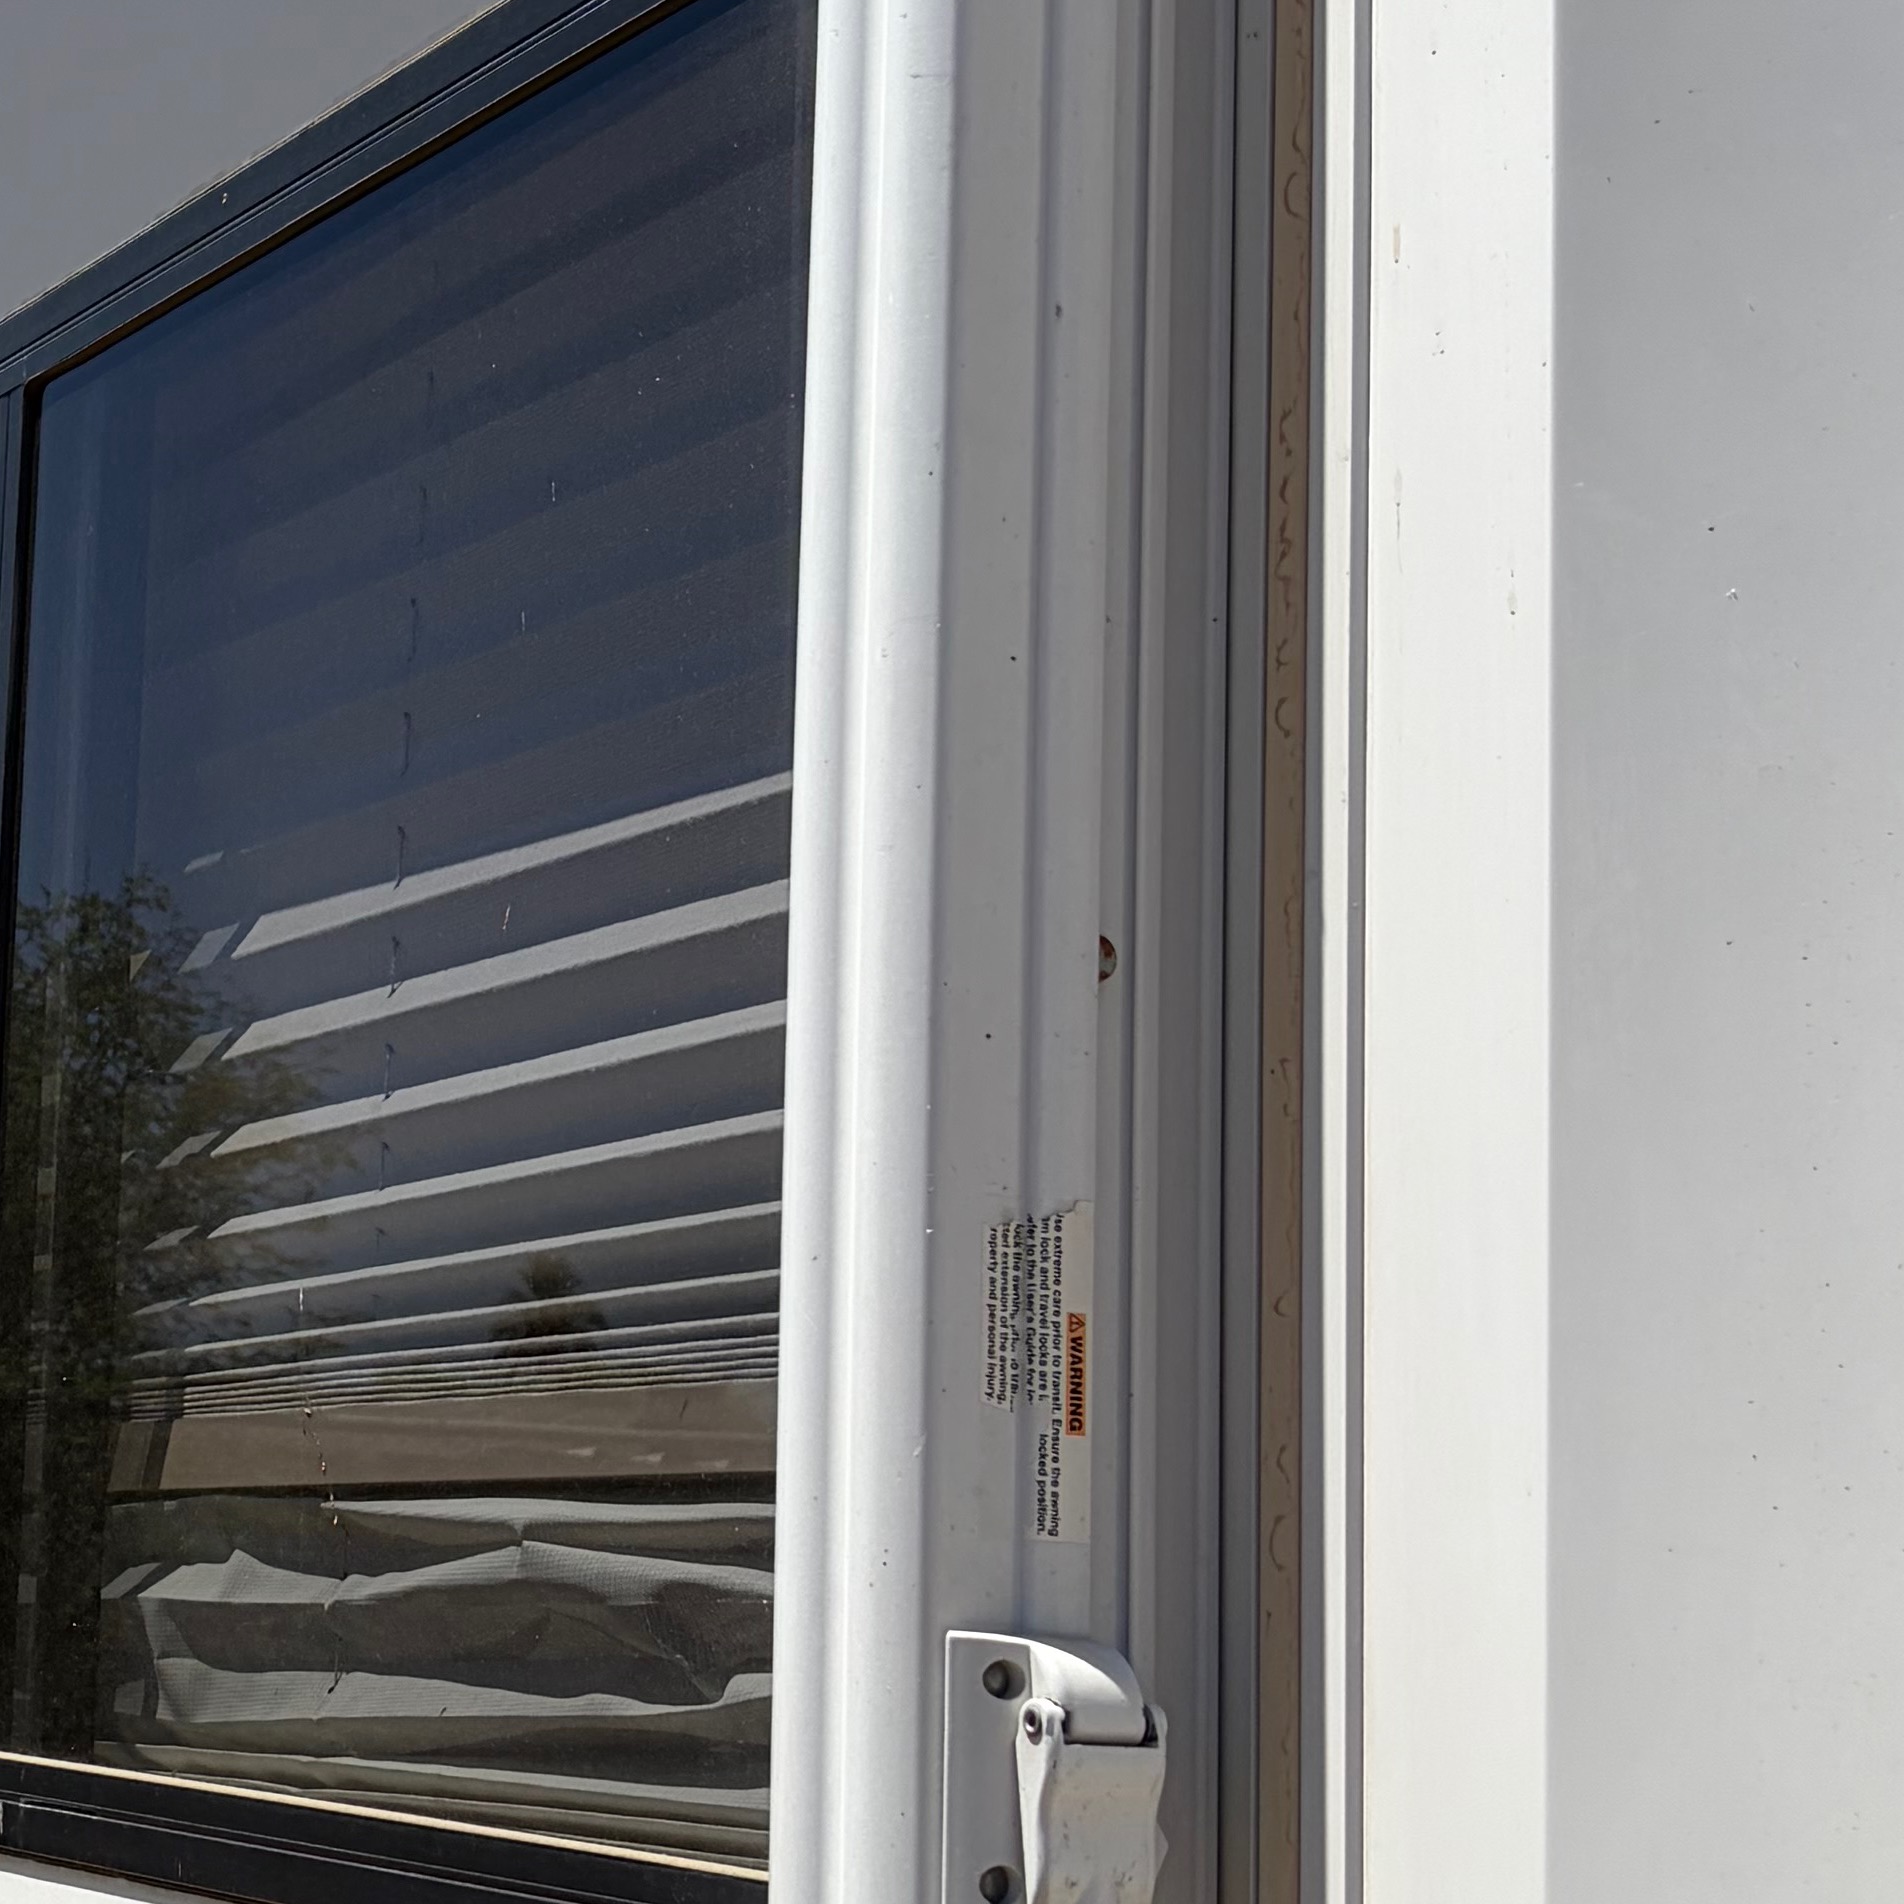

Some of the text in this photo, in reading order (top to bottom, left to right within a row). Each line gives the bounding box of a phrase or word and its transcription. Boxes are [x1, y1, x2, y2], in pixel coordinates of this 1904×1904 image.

[1012, 1253, 1022, 1273] the
[1026, 1244, 1037, 1257] to
[1039, 1237, 1051, 1265] lock
[1053, 1236, 1063, 1287] extreme
[999, 1252, 1009, 1313] extension
[1026, 1260, 1037, 1280] the
[1039, 1266, 1051, 1291] and
[987, 1276, 997, 1301] and
[1038, 1294, 1050, 1330] travel
[1052, 1289, 1062, 1318] care
[984, 1304, 997, 1359] personal
[998, 1316, 1009, 1330] of
[1050, 1321, 1062, 1353] prior
[998, 1333, 1008, 1354] the
[1038, 1333, 1050, 1367] locks
[1052, 1355, 1062, 1368] to
[1038, 1370, 1048, 1392] are
[1069, 1335, 1084, 1433] WARNING
[1037, 1433, 1049, 1477] locked
[1051, 1418, 1063, 1464] Ensure
[1051, 1467, 1062, 1488] the
[1035, 1479, 1048, 1536] position.
[1047, 1490, 1060, 1537] awning
